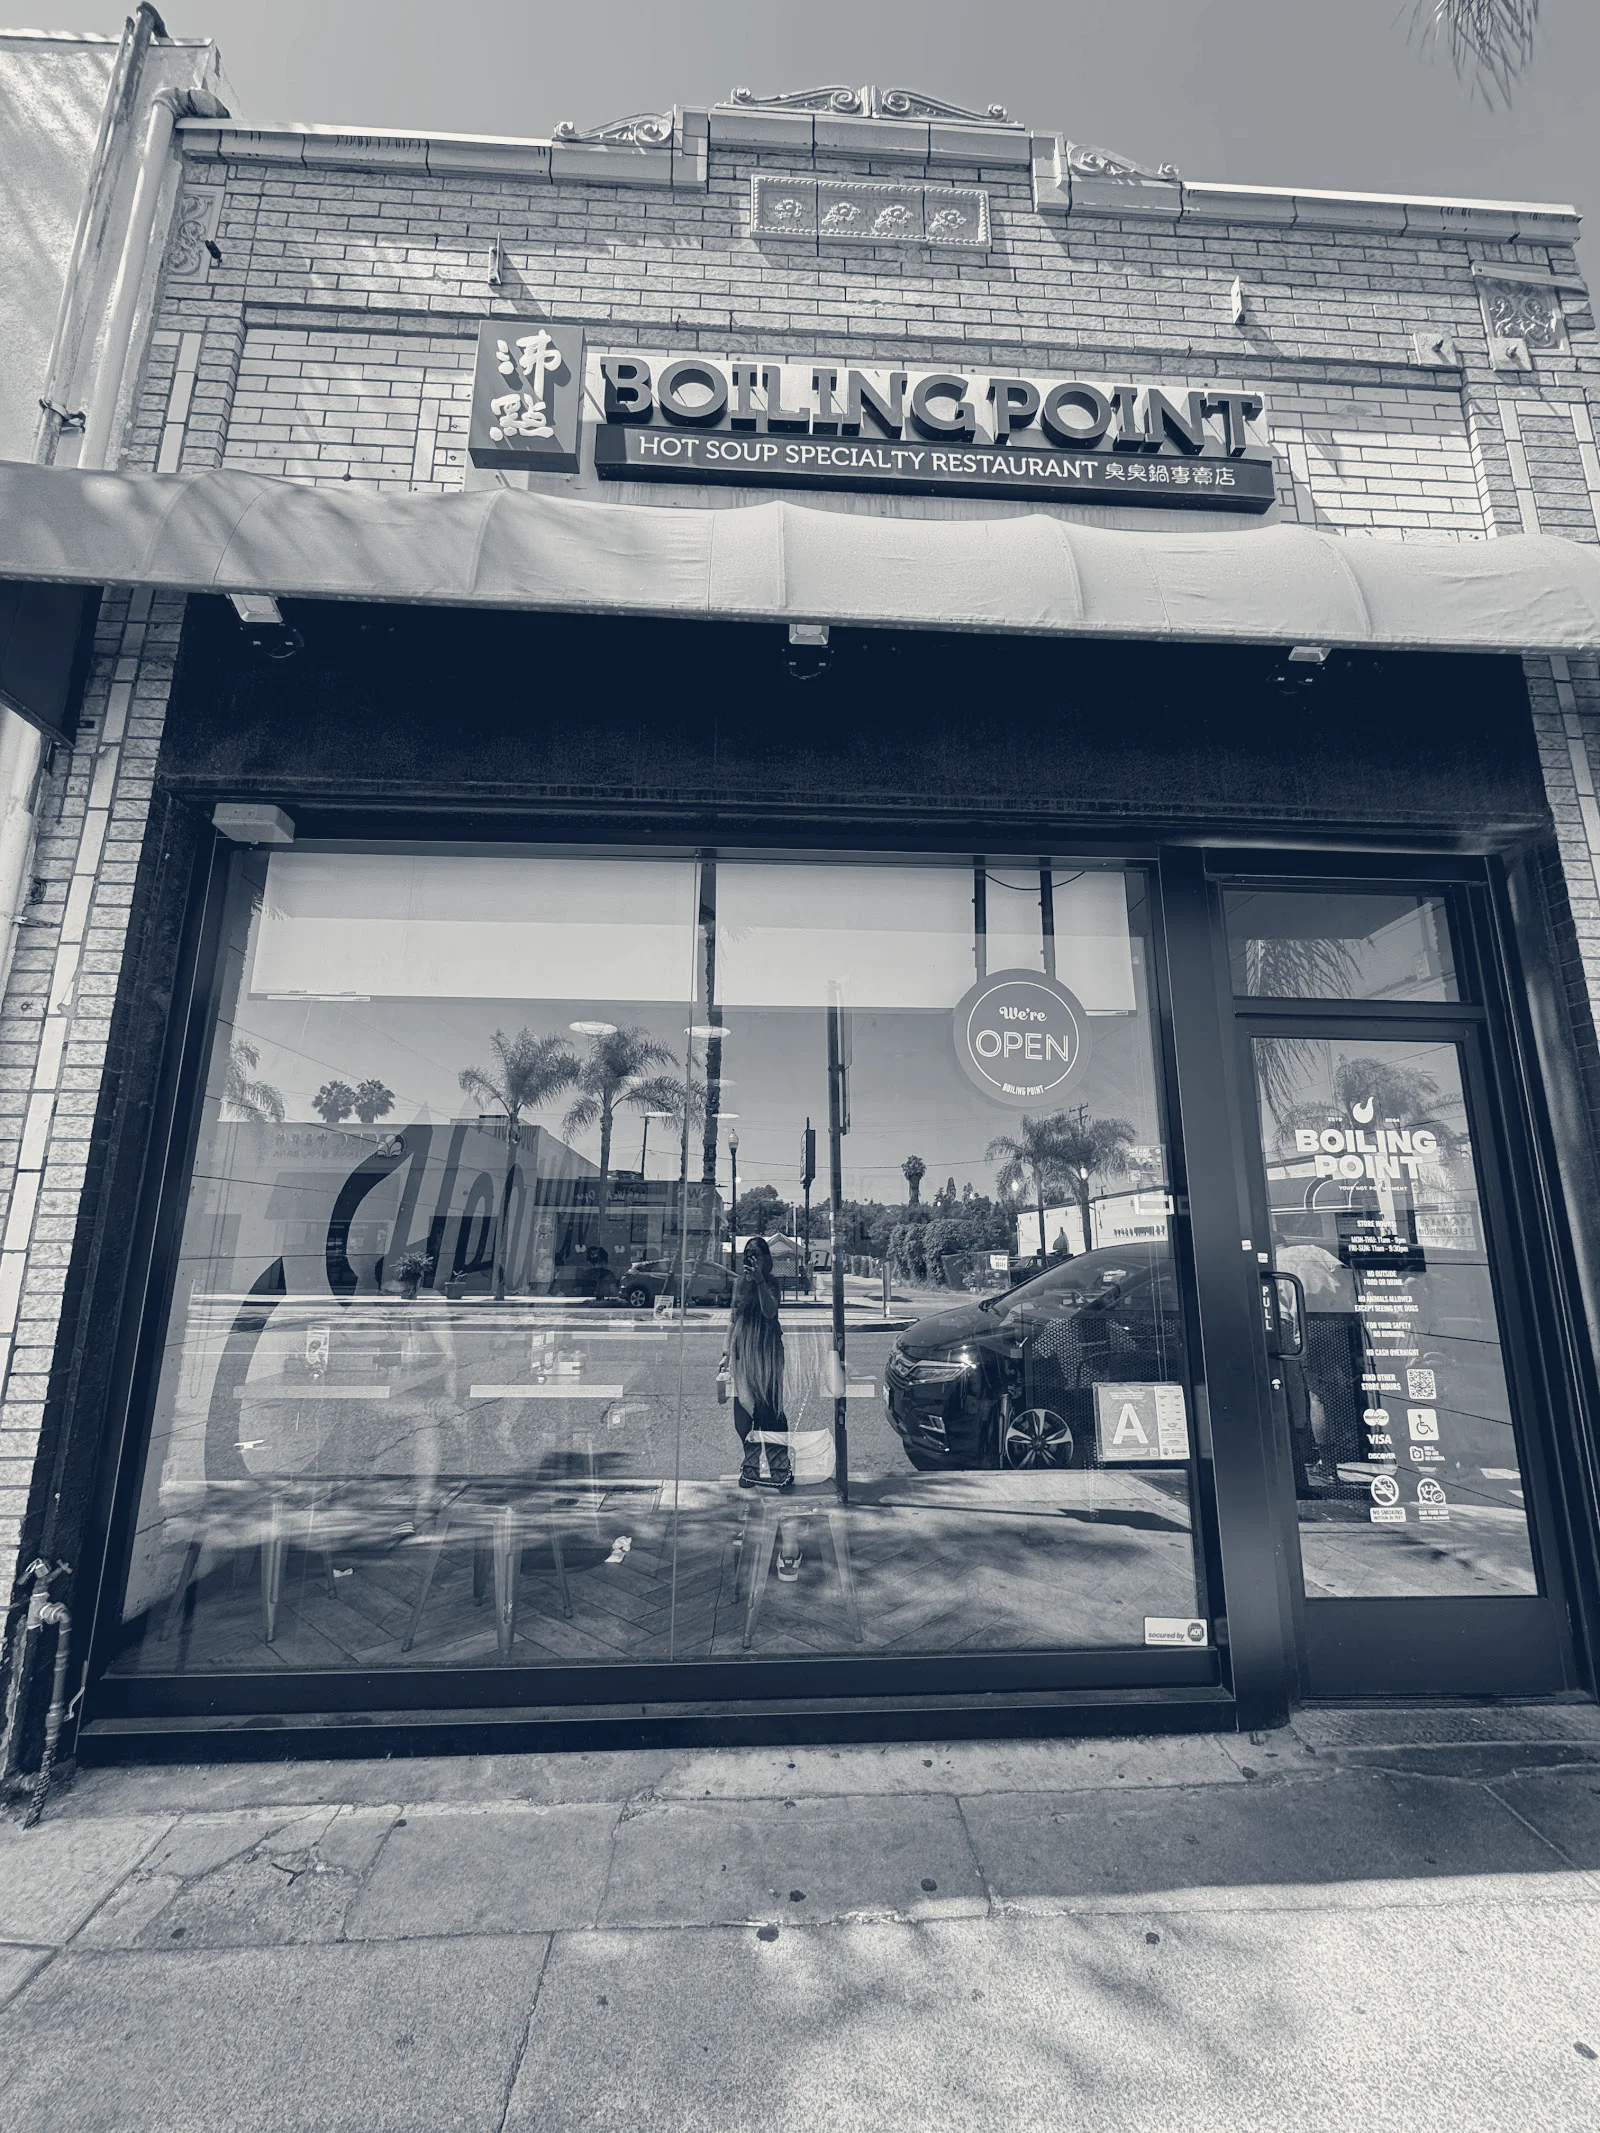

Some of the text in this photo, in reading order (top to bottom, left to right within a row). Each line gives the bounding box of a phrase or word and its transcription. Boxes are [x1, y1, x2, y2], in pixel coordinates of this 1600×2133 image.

[600, 356, 1263, 457] BOILING POINT
[639, 436, 1236, 487] HOT SOUP SPECIALTY RESTAURANT 臭臭鍋專賣店
[998, 1006, 1048, 1022] We're
[975, 1029, 1069, 1062] OPEN
[1001, 1082, 1045, 1096] BOILING POINT
[1295, 1128, 1437, 1154] BOILING
[1314, 1154, 1423, 1180] POINT
[1356, 1220, 1375, 1228] STORE
[1375, 1270, 1397, 1278] OUTSIDE
[1363, 1278, 1378, 1286] FOOD
[1357, 1295, 1366, 1303] NO
[1388, 1295, 1413, 1303] ALLOWED
[1262, 1285, 1273, 1331] PULL
[1354, 1304, 1374, 1312] EXCEPT
[1366, 1321, 1377, 1329] FOR
[1392, 1321, 1411, 1329] SAFETY
[1366, 1348, 1419, 1356] NO CASH OVERNIGHT
[1361, 1382, 1401, 1390] STORE HOURS
[1112, 1403, 1149, 1445] A
[1366, 1434, 1393, 1445] VISA
[1367, 1452, 1396, 1460] DISCOVER
[1176, 1632, 1185, 1640] by
[1189, 1628, 1202, 1636] ADT
